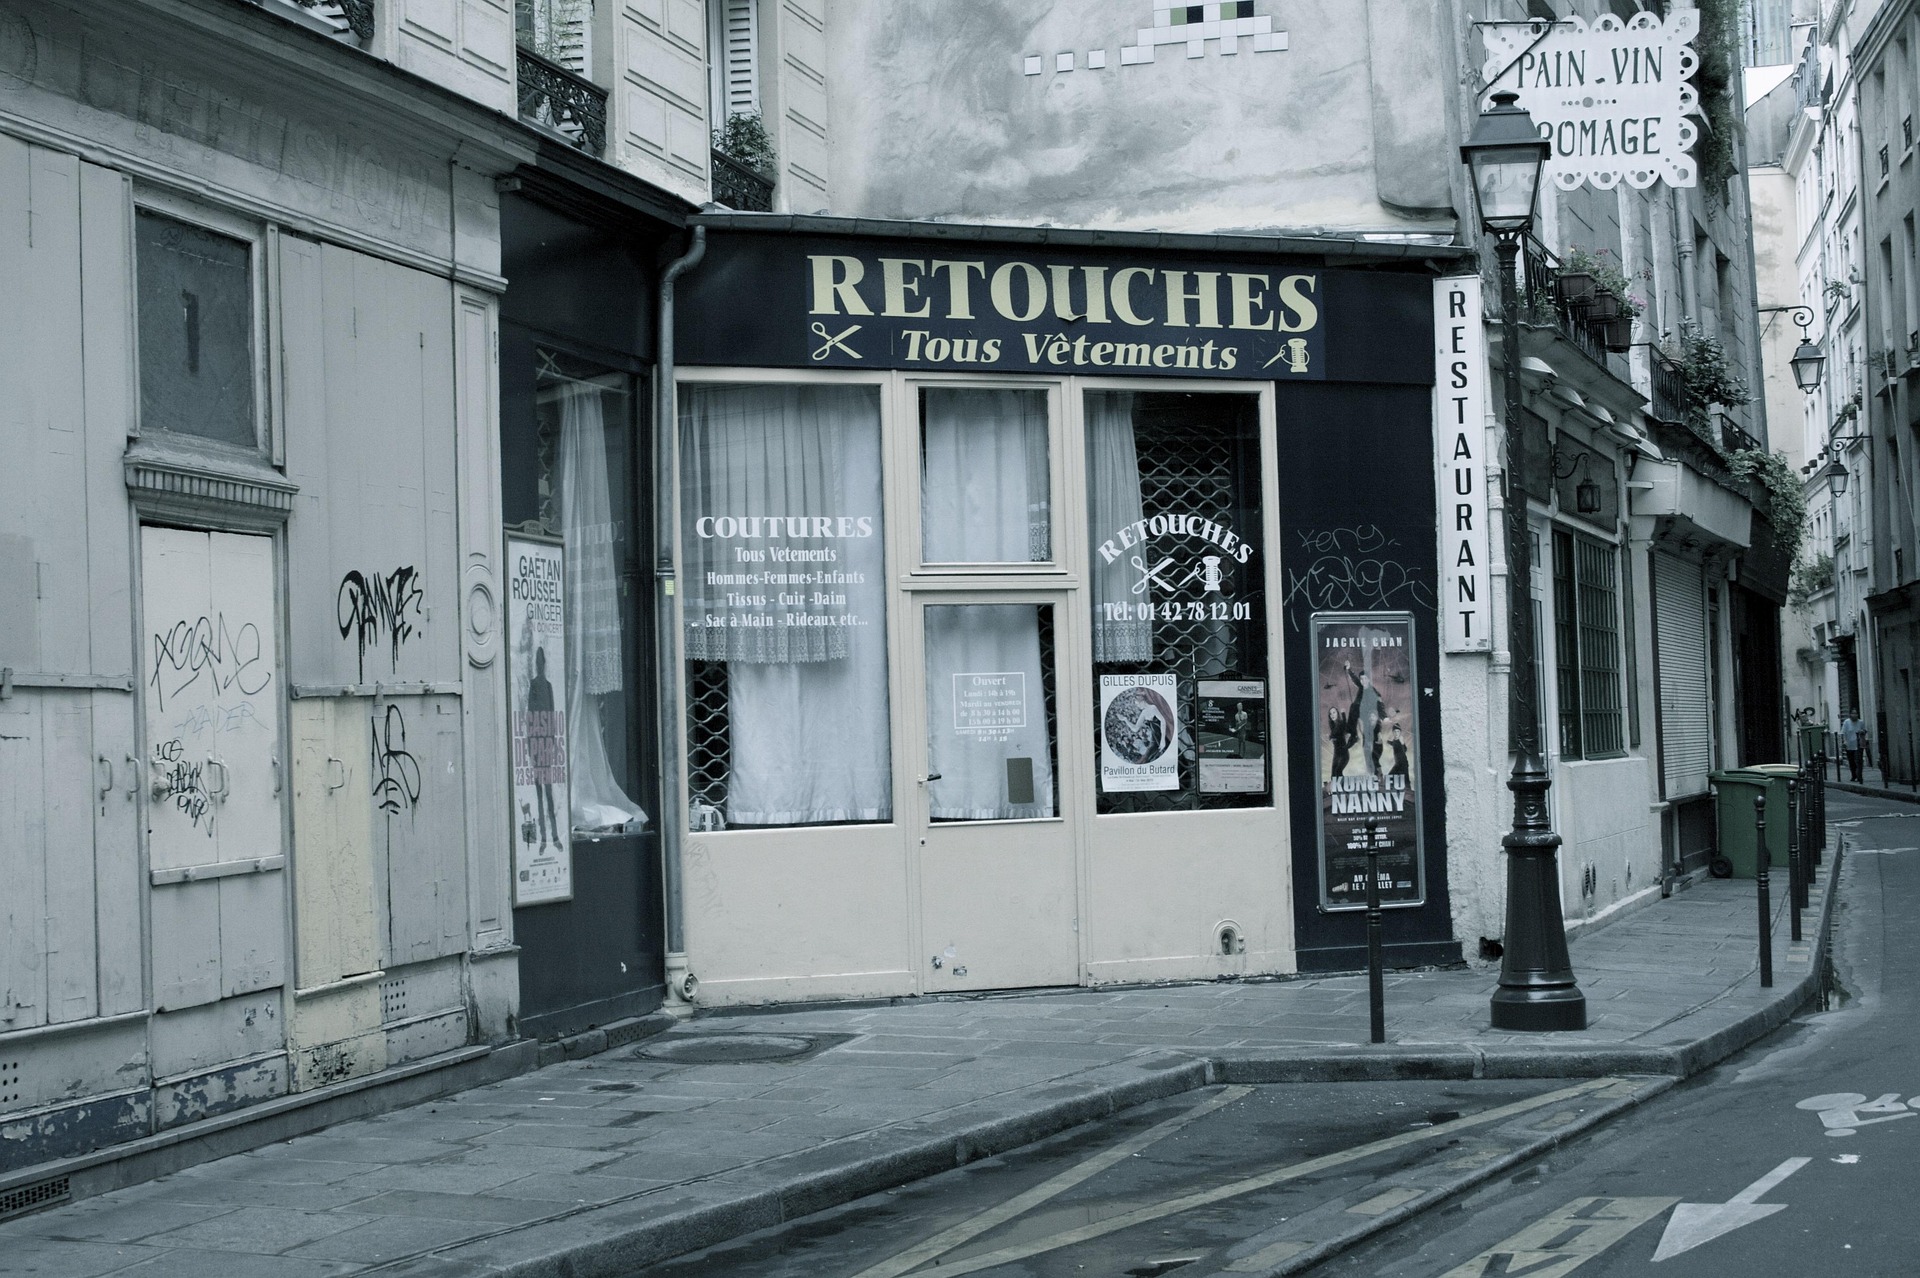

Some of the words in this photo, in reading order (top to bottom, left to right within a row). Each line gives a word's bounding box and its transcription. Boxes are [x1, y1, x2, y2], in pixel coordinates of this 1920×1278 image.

[1517, 49, 1585, 88] PAIN
[1611, 46, 1663, 85] VIN
[807, 255, 1319, 332] RETOUCHES
[901, 329, 1002, 363] Tous
[1022, 331, 1238, 370] Vêtements
[1448, 290, 1476, 639] RESTAURANT
[696, 516, 873, 539] COUTURES
[1098, 514, 1254, 565] RETOUCHES
[735, 546, 765, 562] Tous
[769, 546, 837, 562] Vetements
[707, 570, 865, 585] Hommes-Femmes-Enfants
[512, 577, 561, 603] ROUSSEL
[727, 592, 767, 606] Tissus
[778, 591, 805, 606] Cuir
[526, 602, 562, 622] GINGER
[706, 613, 726, 627] Sac
[730, 613, 737, 627] à
[742, 613, 774, 627] Main
[787, 612, 836, 626] Rideaux
[1104, 601, 1132, 621] Tél:
[1138, 602, 1156, 621] 01
[1161, 602, 1182, 621] 42
[1187, 602, 1205, 621] 78
[1209, 602, 1228, 621] 12
[1233, 602, 1251, 621] 01
[1325, 637, 1366, 648] JACKIE
[1372, 637, 1402, 648] CHAN
[972, 676, 1006, 686] Ouvert
[1103, 676, 1135, 687] GILLES
[1138, 675, 1174, 686] DUPUIS
[960, 700, 981, 708] Mardi
[514, 711, 524, 737] LE
[527, 711, 565, 737] CASINO
[515, 738, 529, 767] DE
[530, 737, 565, 767] PARIS
[516, 768, 525, 786] 23
[526, 767, 566, 785] SEPTEMBRE
[1103, 766, 1135, 776] Pavillon
[1137, 765, 1147, 775] du
[1150, 764, 1175, 775] Butard
[1331, 775, 1380, 792] KUNG
[1385, 774, 1406, 790] FU
[1331, 791, 1406, 814] NANNY
[1354, 874, 1363, 883] AU
